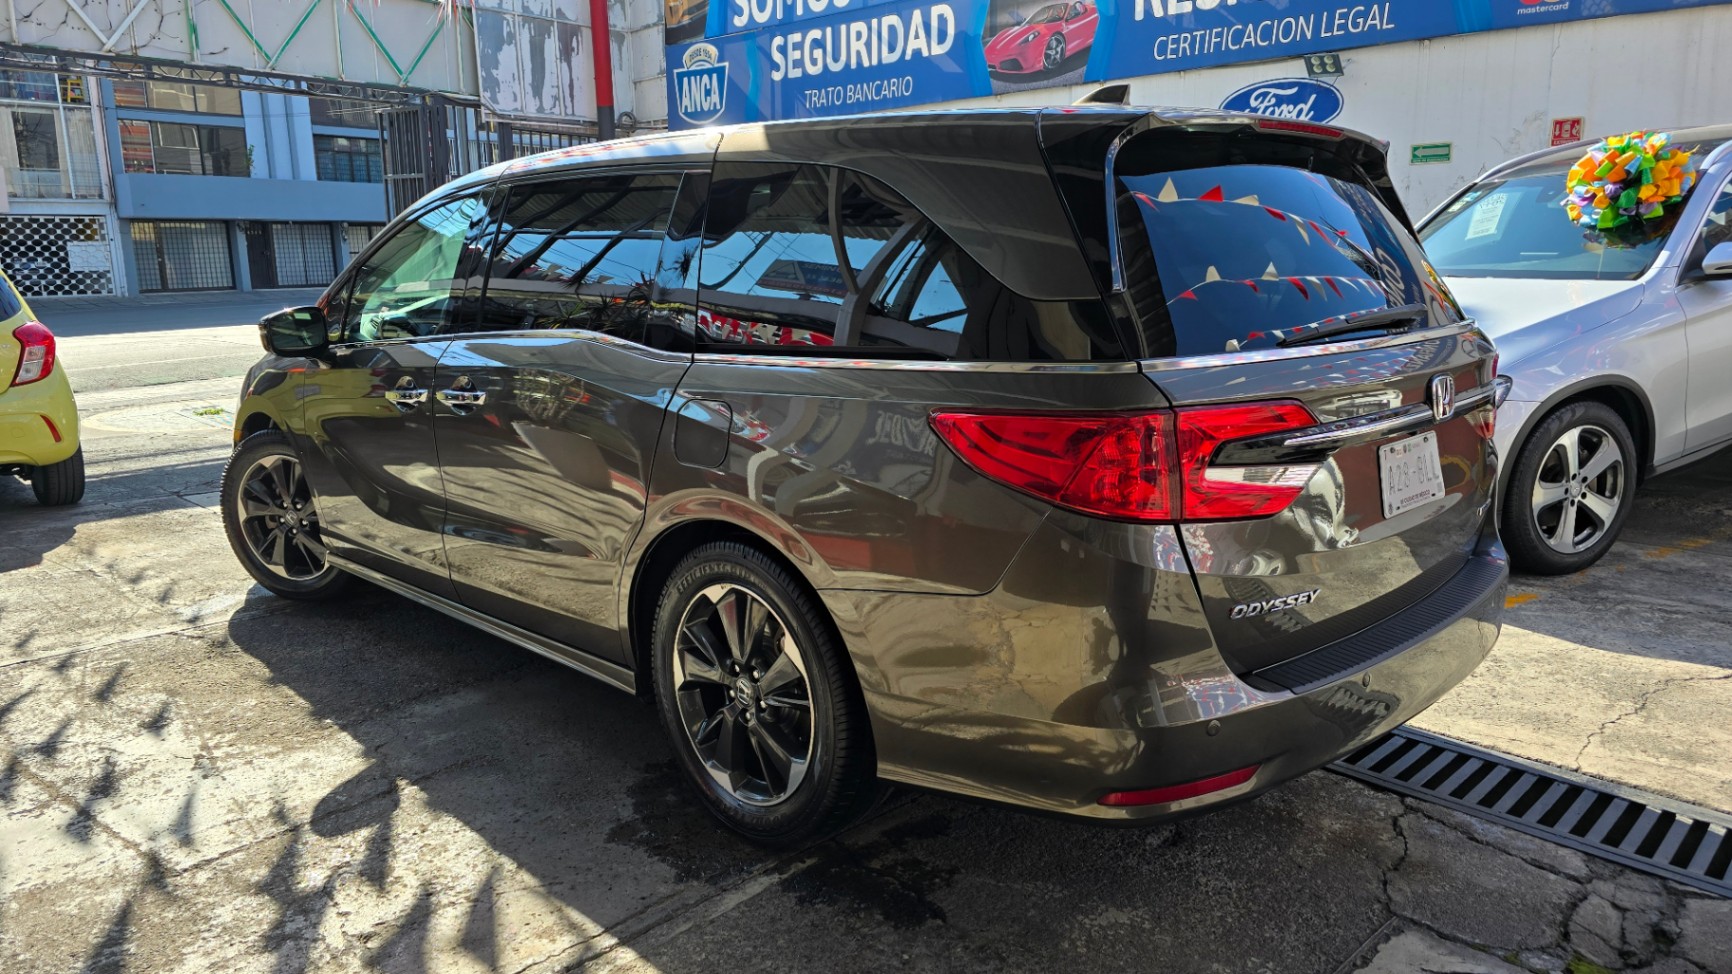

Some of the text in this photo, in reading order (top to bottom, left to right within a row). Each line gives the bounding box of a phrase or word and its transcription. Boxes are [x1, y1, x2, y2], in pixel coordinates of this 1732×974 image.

[1517, 2, 1569, 15] mastercard
[770, 4, 955, 81] SEGURIDAD
[1153, 3, 1395, 61] CERTIFICACION LEGAL
[682, 73, 720, 113] ANCA
[804, 76, 913, 109] TRATO BANCARIO
[1247, 86, 1317, 120] Ford
[1229, 588, 1322, 619] ODYSSEY
